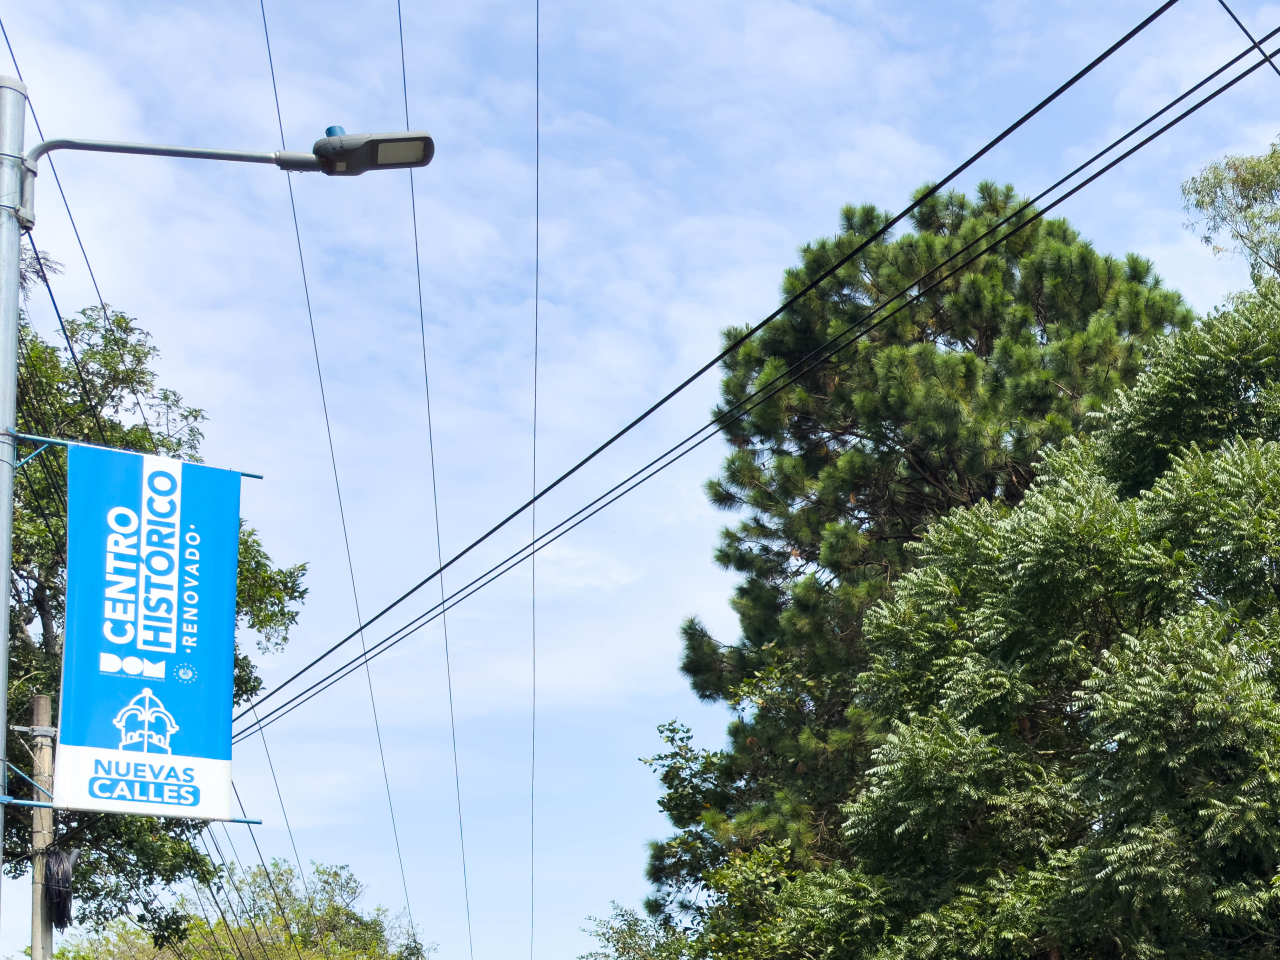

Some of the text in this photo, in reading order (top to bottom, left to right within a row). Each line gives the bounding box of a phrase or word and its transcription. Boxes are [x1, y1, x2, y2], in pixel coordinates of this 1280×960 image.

[103, 506, 139, 644] CENTRO
[140, 470, 178, 649] HISTÓRICO
[93, 779, 194, 805] CALLES
[94, 759, 195, 783] NUEVAS
